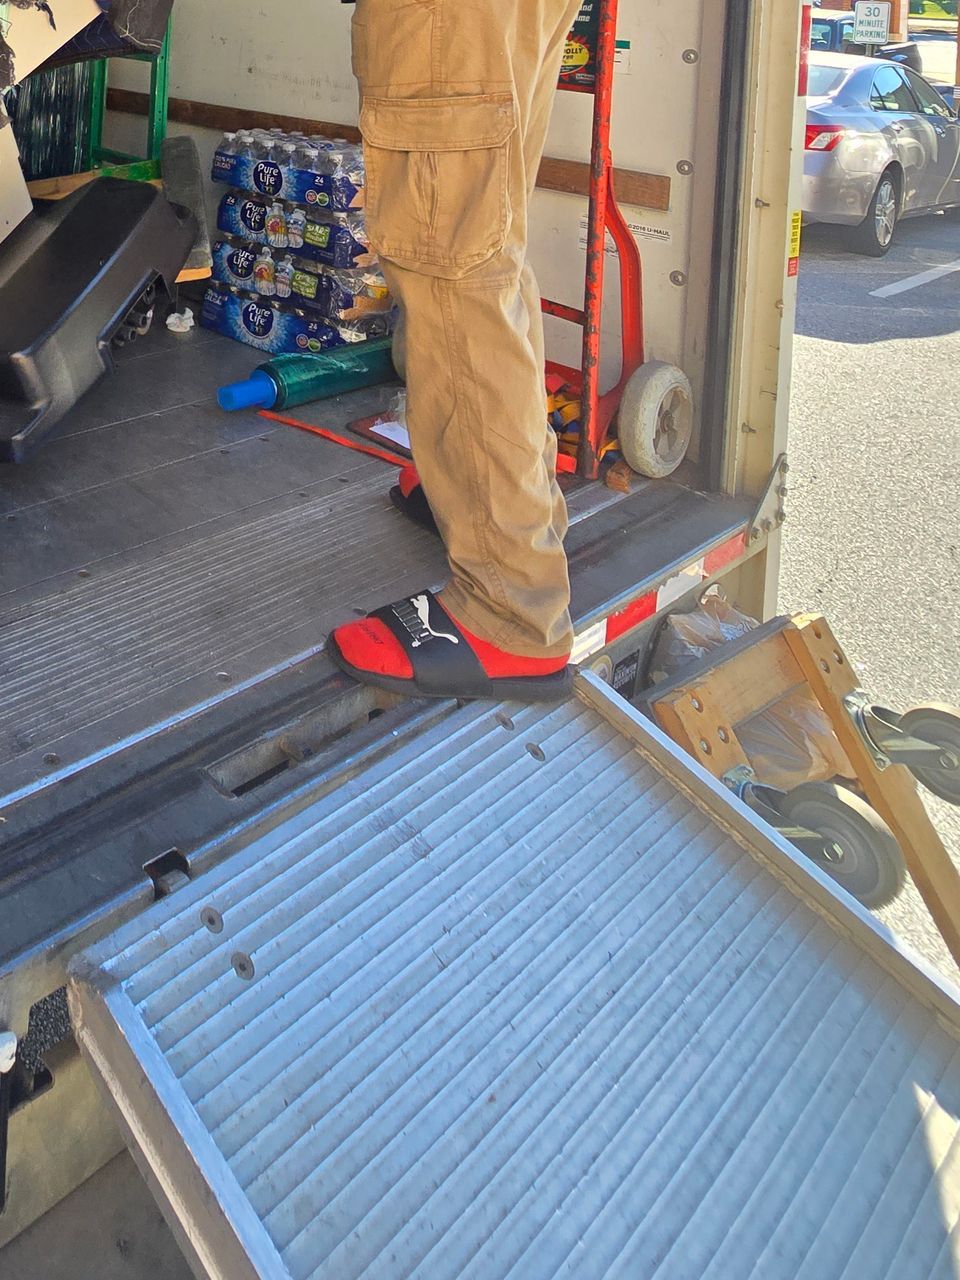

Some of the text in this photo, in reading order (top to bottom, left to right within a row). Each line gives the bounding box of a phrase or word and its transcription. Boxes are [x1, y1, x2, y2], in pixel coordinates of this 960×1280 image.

[864, 6, 880, 17] 30
[858, 19, 884, 28] MINUTE
[856, 30, 885, 39] PARKING
[563, 47, 584, 56] OLLY
[258, 163, 279, 176] Pure
[259, 173, 276, 185] Life
[314, 176, 324, 184] 24
[245, 201, 266, 214] Pure
[246, 210, 261, 224] Life
[238, 249, 255, 261] ure
[233, 256, 249, 268] Life
[248, 303, 271, 317] Pure
[249, 313, 265, 326] Life
